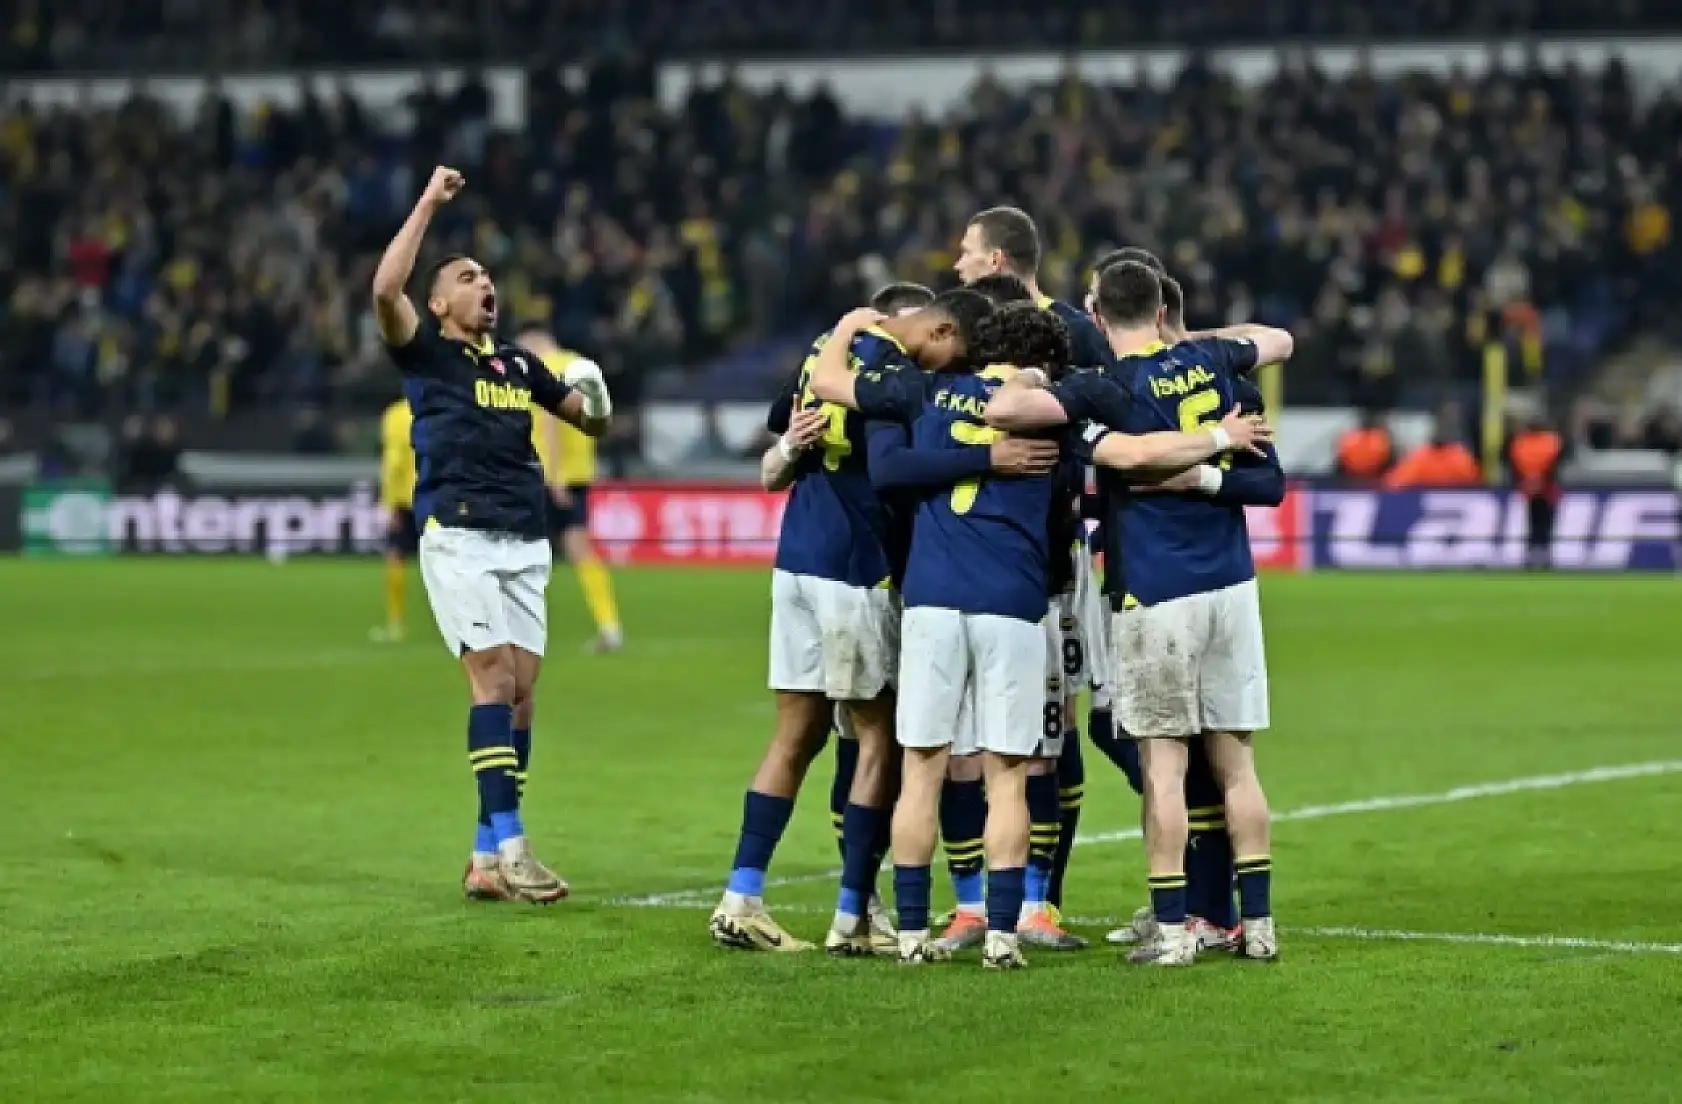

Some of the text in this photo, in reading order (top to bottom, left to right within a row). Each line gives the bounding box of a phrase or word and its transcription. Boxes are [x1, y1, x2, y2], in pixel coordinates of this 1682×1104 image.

[22, 483, 391, 566] enterpri
[1063, 638, 1083, 674] 9
[1044, 700, 1062, 739] 8
